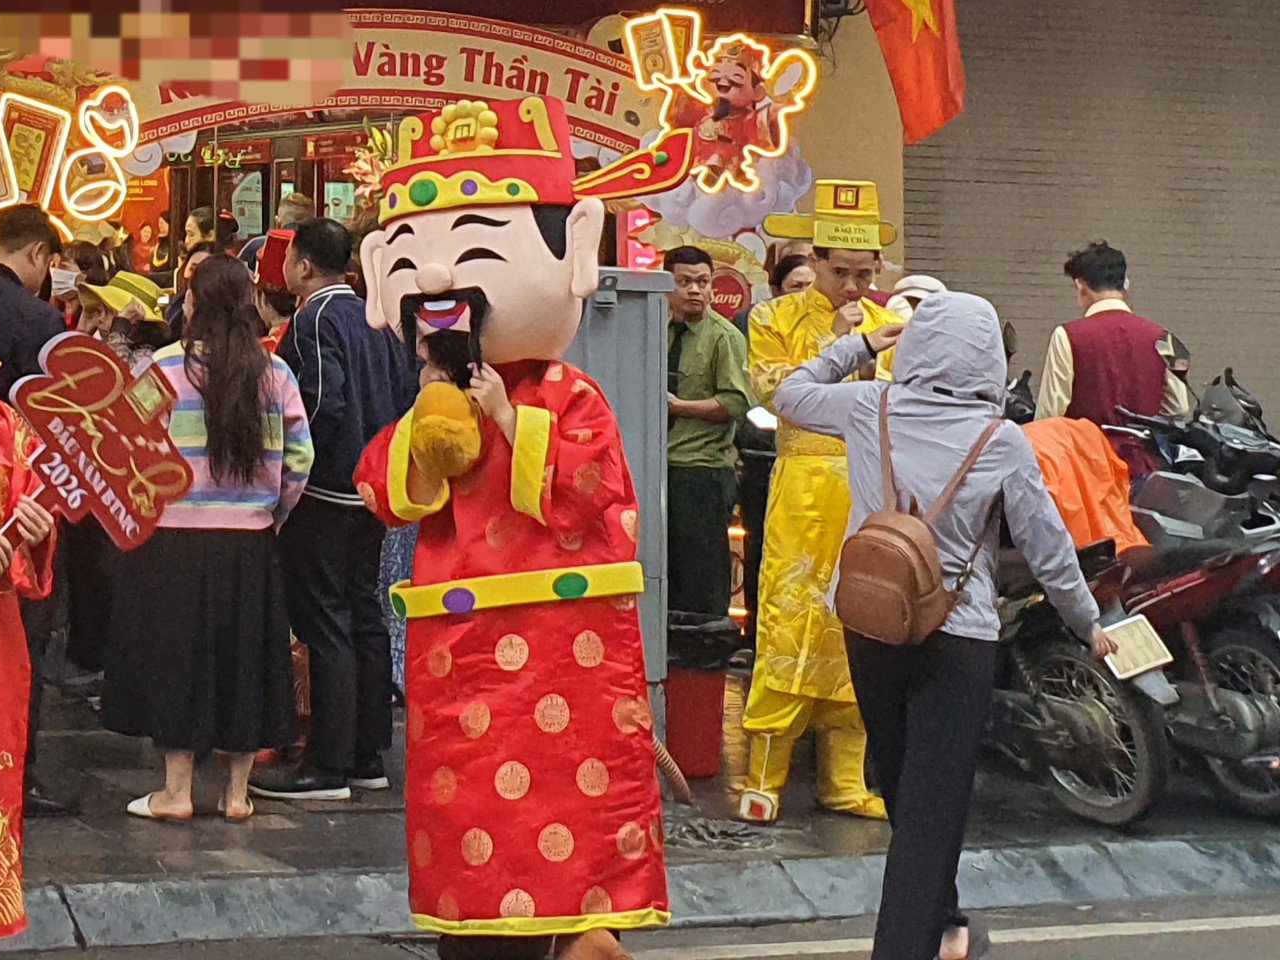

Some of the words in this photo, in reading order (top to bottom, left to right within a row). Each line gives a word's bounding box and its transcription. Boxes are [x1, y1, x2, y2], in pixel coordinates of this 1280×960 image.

[353, 41, 448, 86] Vàng
[459, 46, 550, 97] Thần
[563, 66, 622, 117] Tài
[40, 452, 88, 509] 2026
